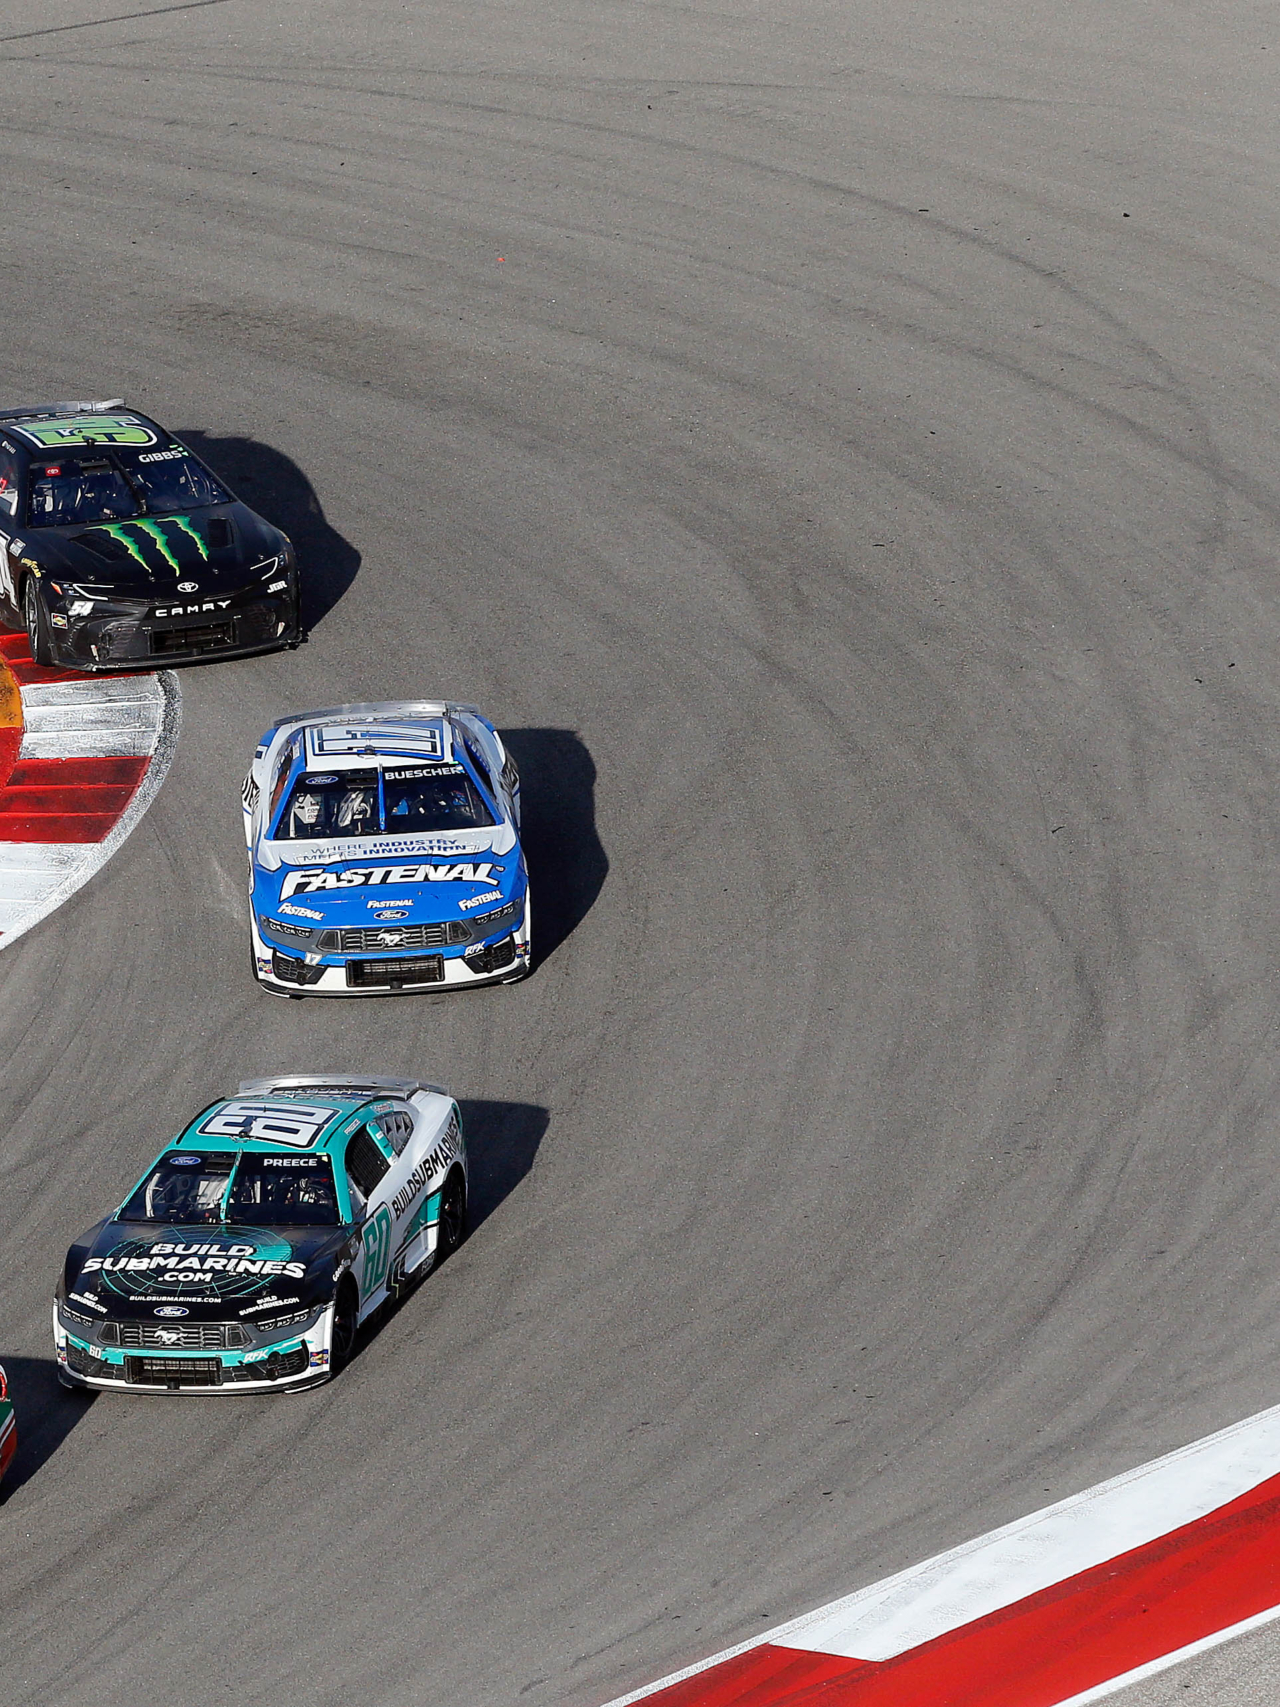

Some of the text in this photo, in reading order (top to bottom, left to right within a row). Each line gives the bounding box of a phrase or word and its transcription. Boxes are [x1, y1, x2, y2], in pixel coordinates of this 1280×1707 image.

[138, 450, 182, 463] GIBBS
[267, 580, 288, 593] JGR
[67, 600, 95, 616] 54
[155, 600, 231, 617] CAMRY
[384, 766, 464, 780] BUESCHER
[310, 839, 458, 854] WHERE INDUSTRY
[363, 845, 466, 855] INNOVATION
[280, 863, 499, 901] FASTENAL
[367, 899, 413, 909] FASTENAL
[458, 890, 504, 911] FASTENAL
[277, 902, 325, 921] FASTENAL
[377, 910, 406, 920] Ford
[464, 941, 485, 956] RFK
[304, 952, 322, 966] 17
[263, 1158, 318, 1167] PREECE
[150, 1243, 255, 1256] BUILD
[362, 1206, 392, 1298] 60
[81, 1257, 307, 1279] SUBMARINES
[157, 1271, 213, 1283] .COM
[239, 1297, 300, 1316] SUBMARINES.COM
[257, 1295, 278, 1305] BUILD
[157, 1306, 186, 1317] Ford
[89, 1344, 102, 1360] 60
[243, 1349, 269, 1362] RFK
